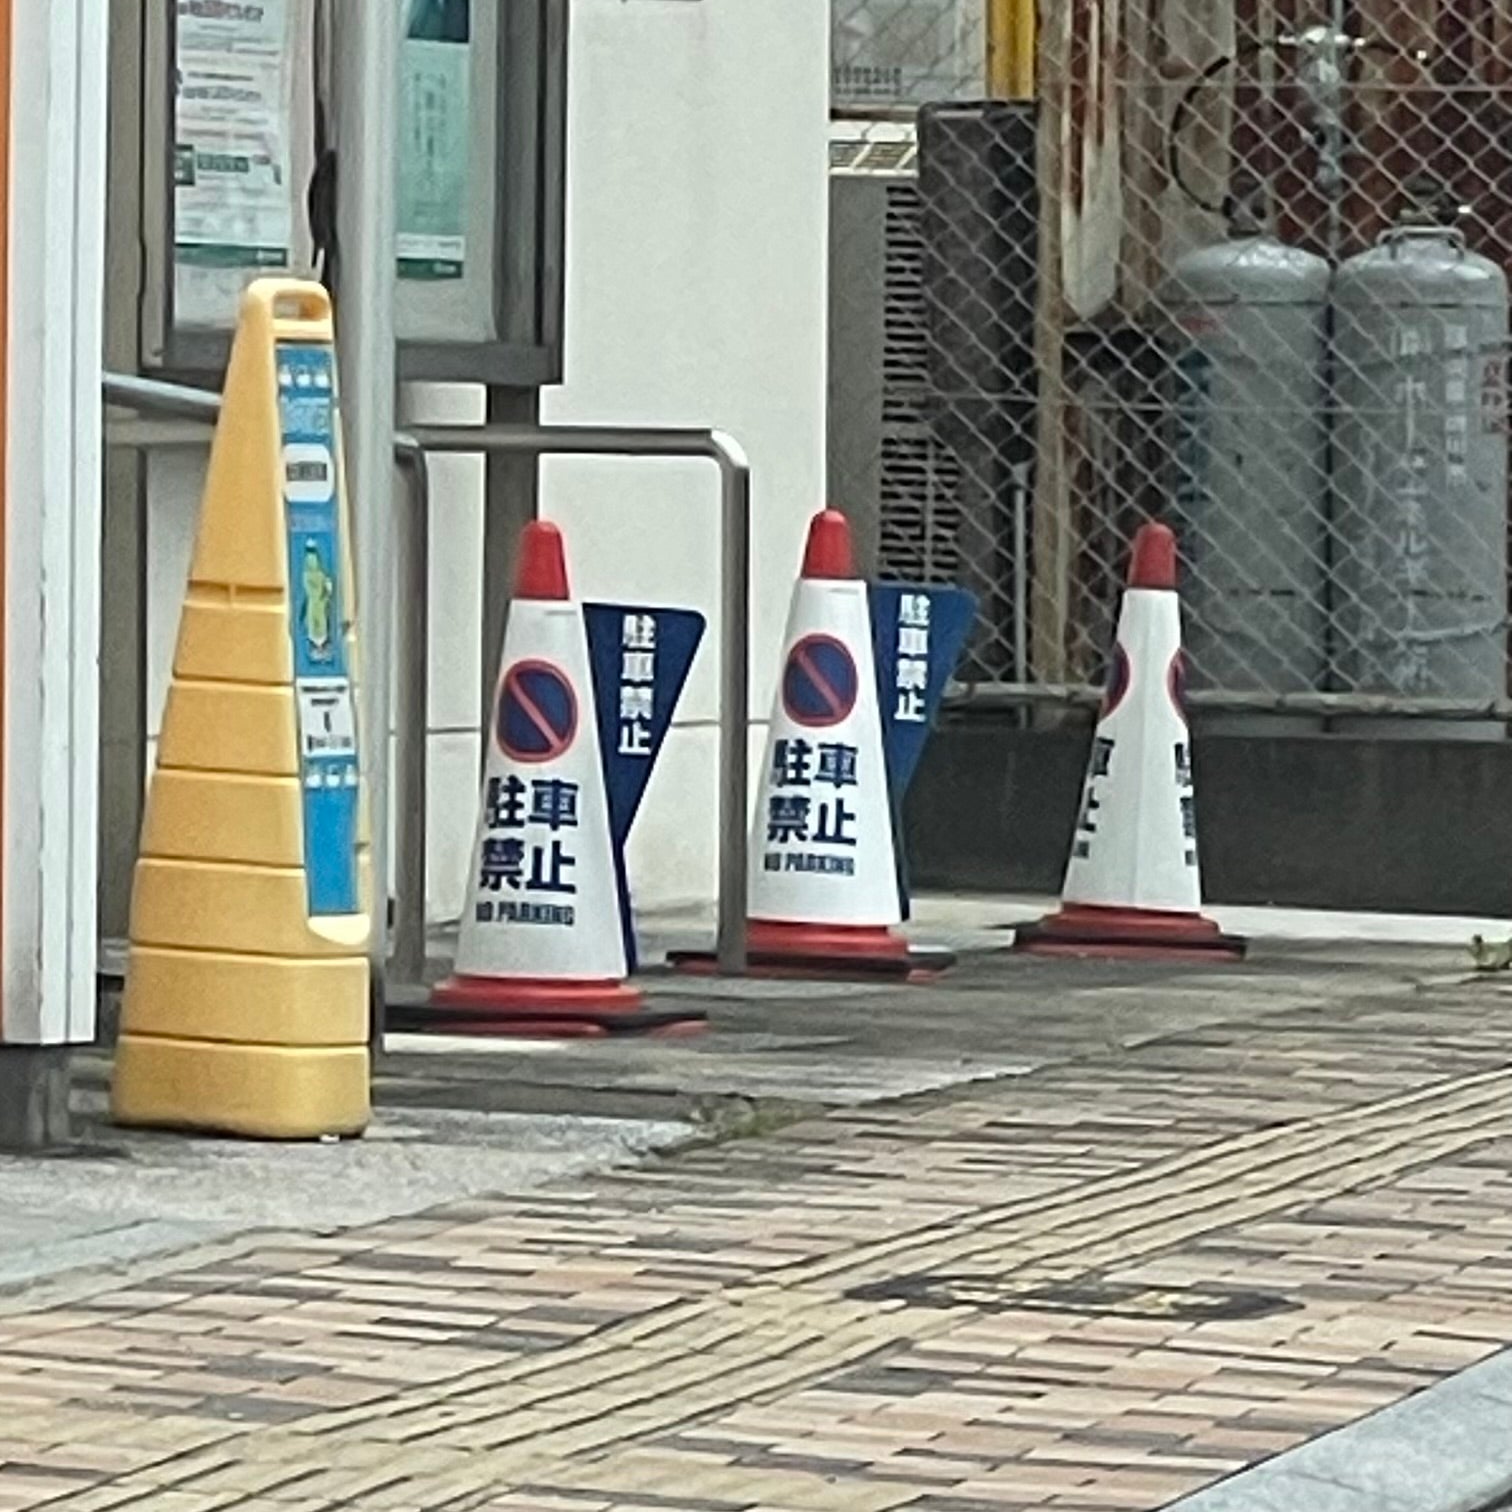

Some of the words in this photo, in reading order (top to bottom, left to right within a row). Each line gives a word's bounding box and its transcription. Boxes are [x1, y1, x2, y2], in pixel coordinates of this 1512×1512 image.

[770, 738, 859, 788] 駐車
[488, 774, 579, 830] 駐車
[767, 795, 858, 846] 禁止
[479, 838, 577, 893] 禁止
